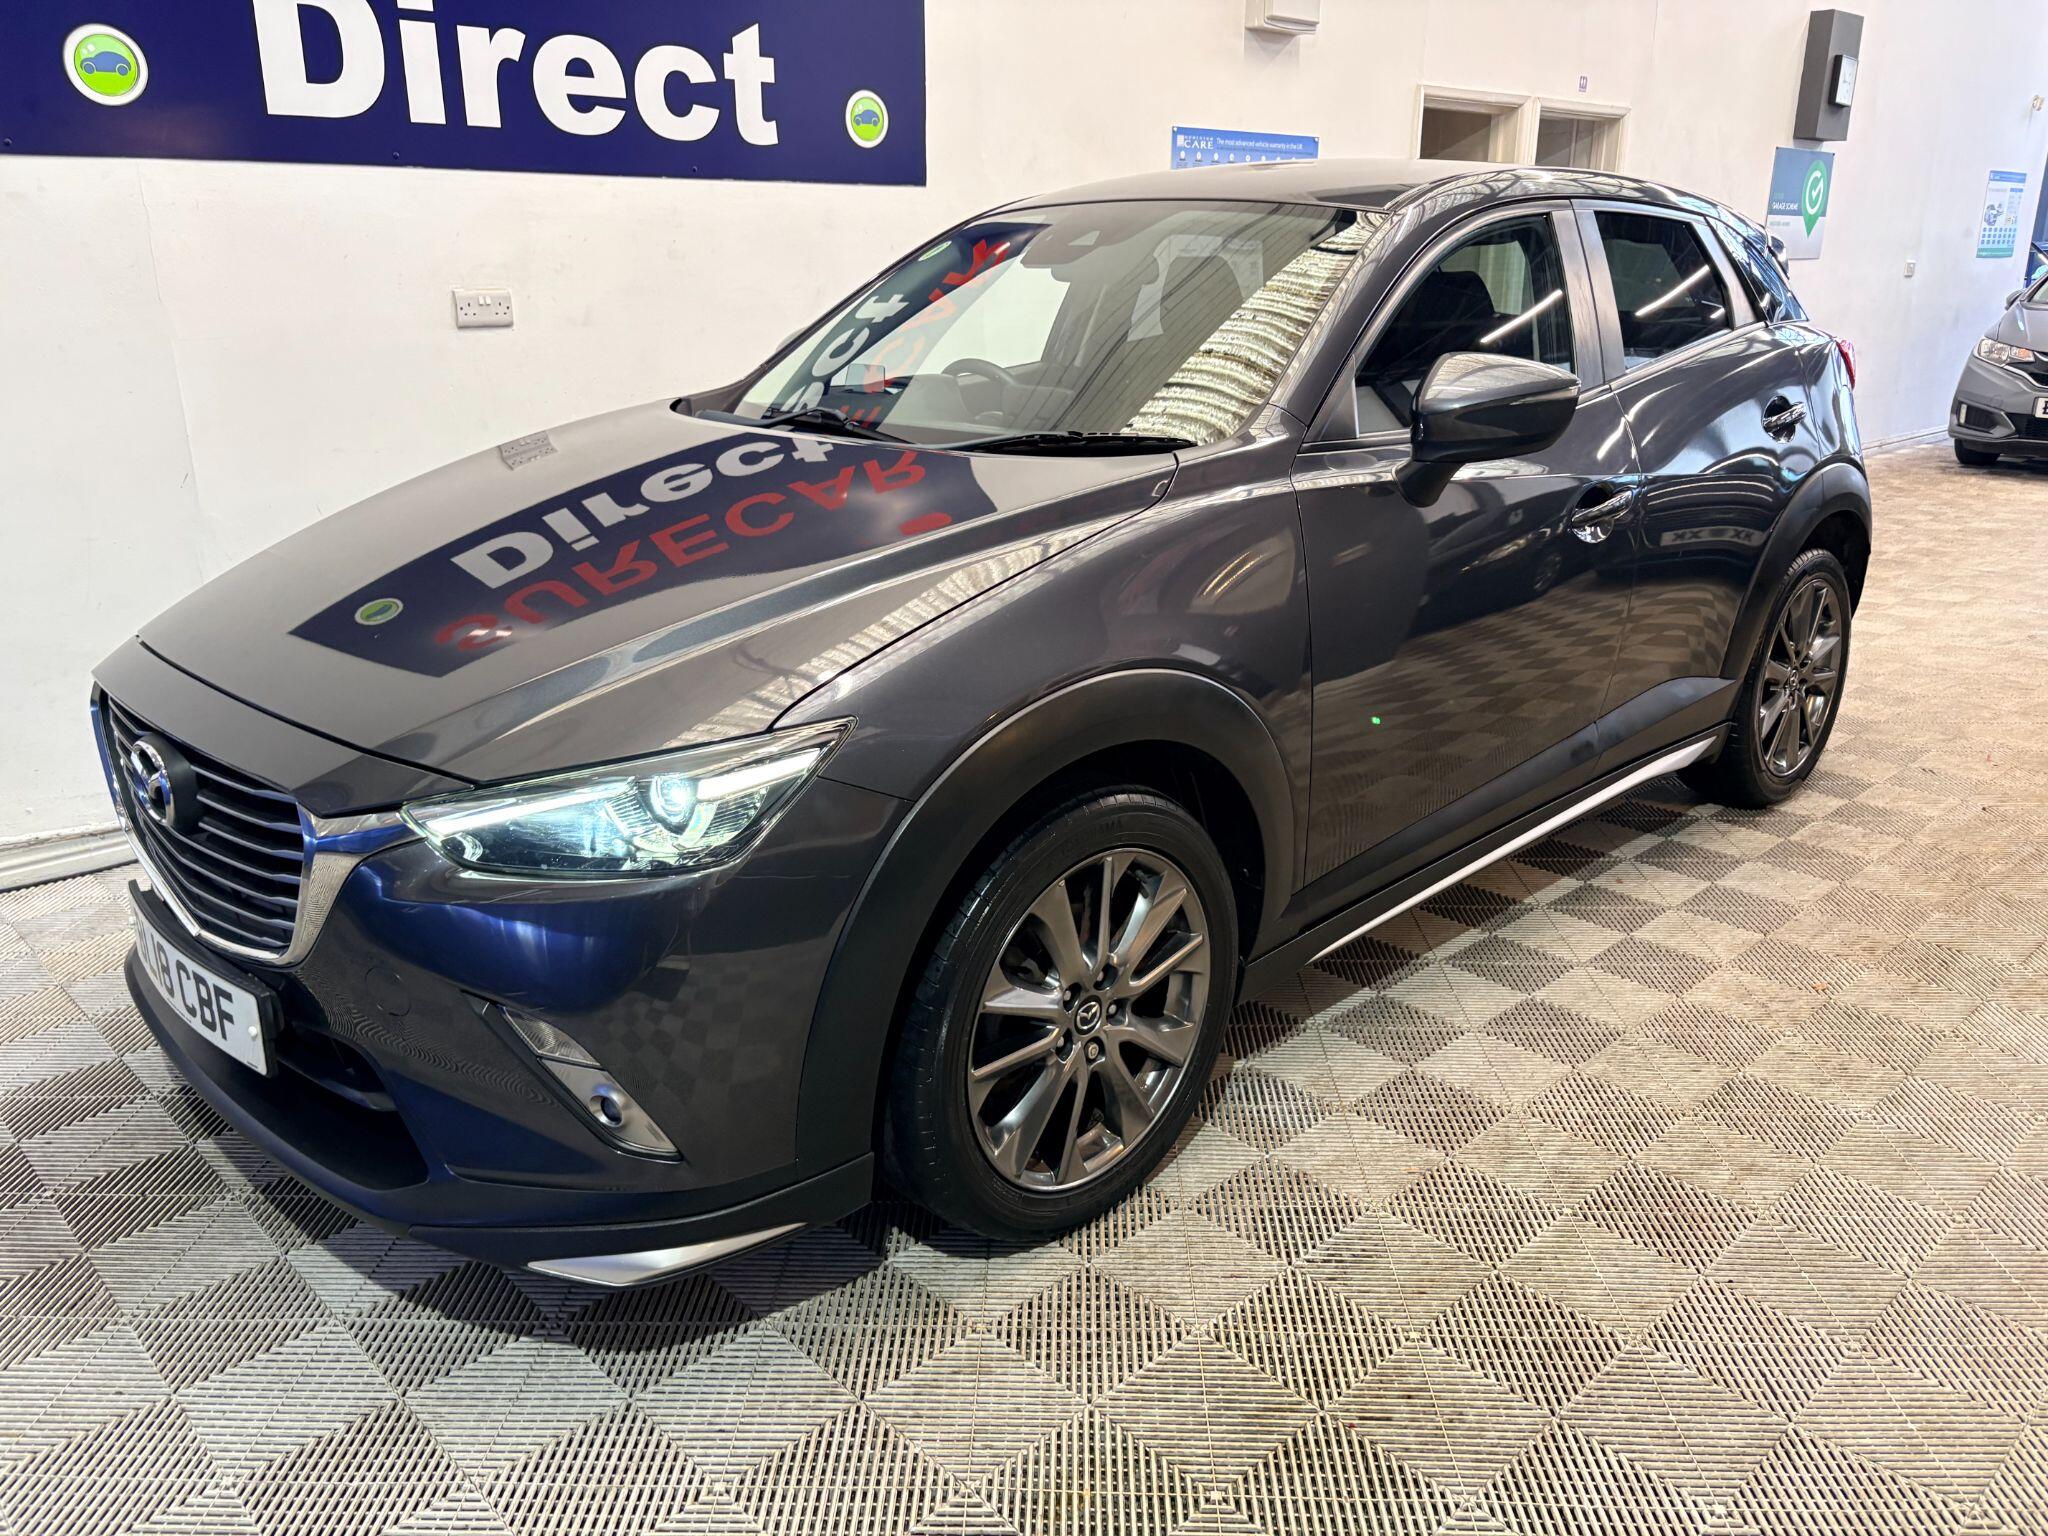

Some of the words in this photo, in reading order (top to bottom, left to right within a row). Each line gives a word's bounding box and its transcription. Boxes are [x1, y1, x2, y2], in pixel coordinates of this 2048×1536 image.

[252, 0, 780, 146] Direct
[1184, 140, 1214, 150] CARE
[175, 959, 235, 1041] CBF
